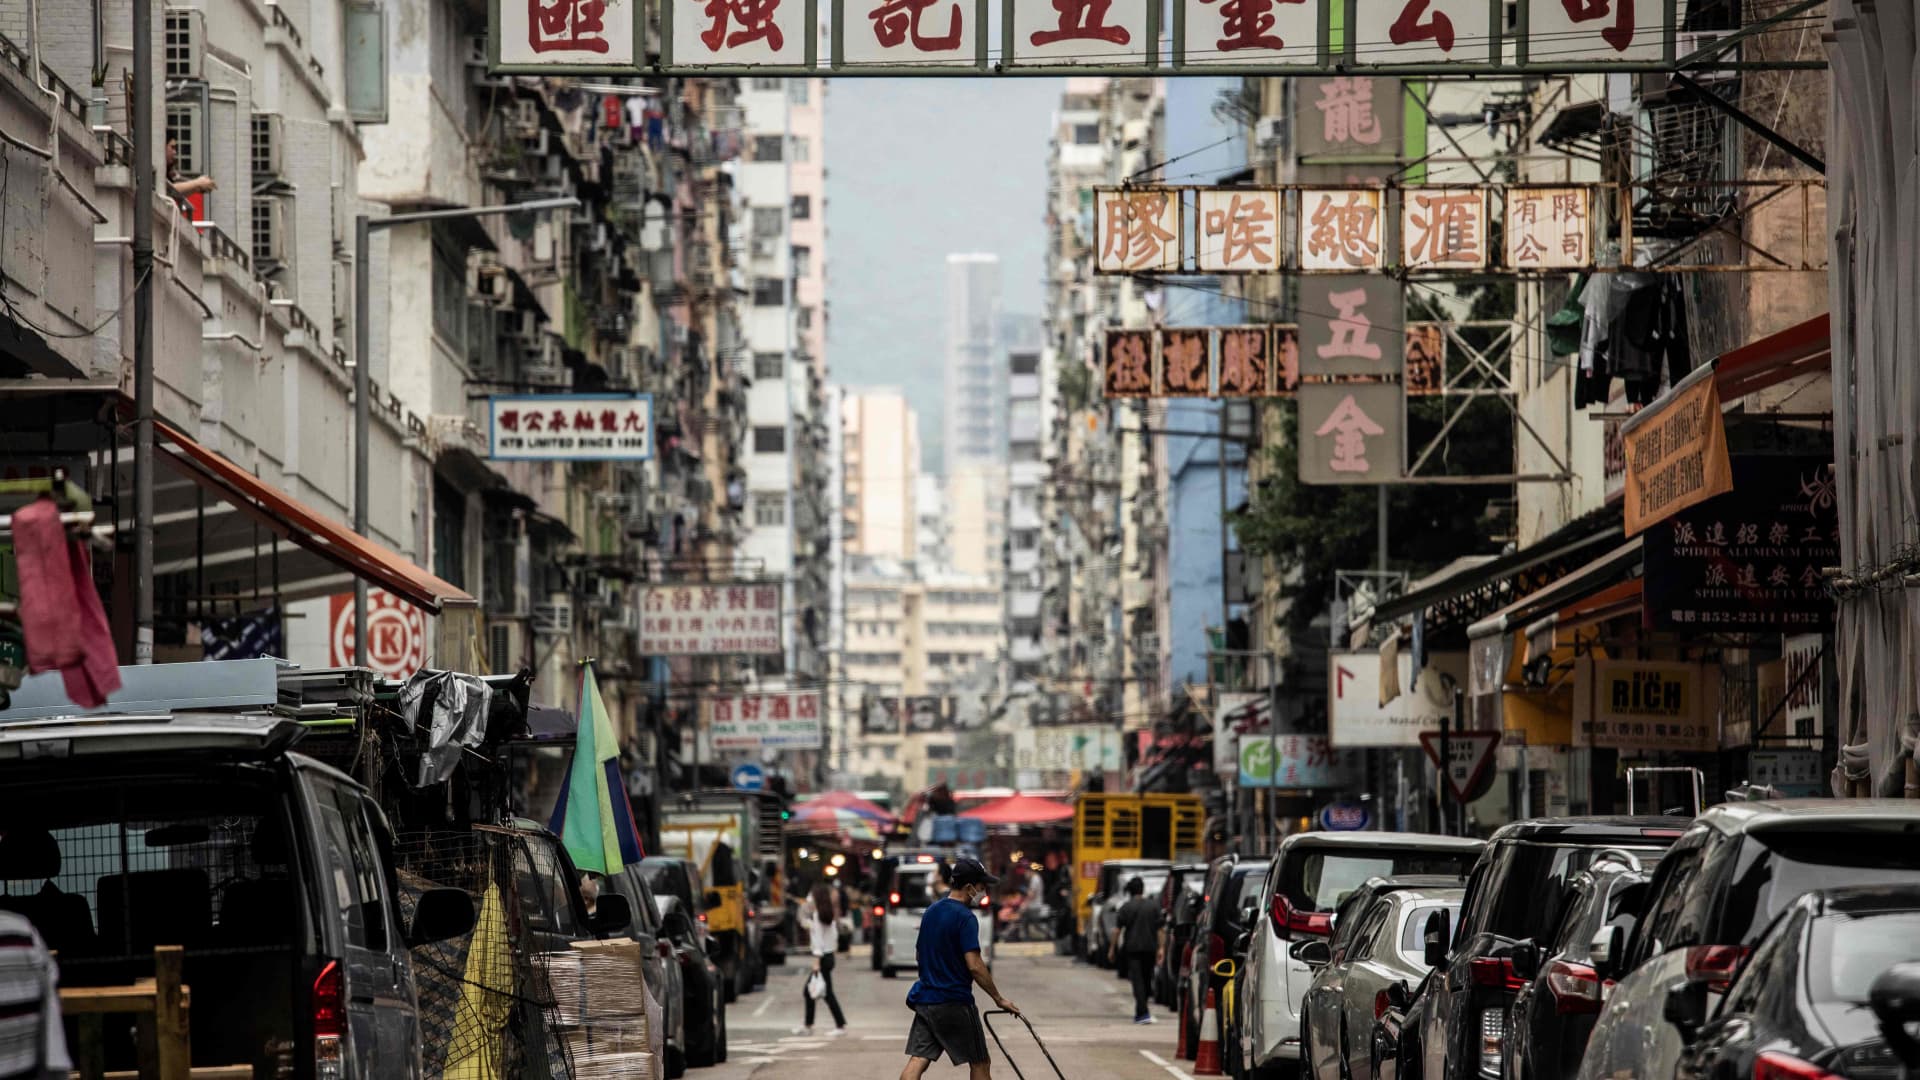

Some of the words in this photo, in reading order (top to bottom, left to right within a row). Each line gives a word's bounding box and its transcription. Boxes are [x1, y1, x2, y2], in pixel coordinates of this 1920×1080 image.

[1512, 193, 1586, 225] 有限
[1512, 230, 1586, 264] 公司
[528, 437, 573, 448] LIMITED
[578, 437, 613, 448] SINCE
[1673, 547, 1721, 557] SPIDER
[1729, 547, 1801, 557] ALUMINUM
[1808, 547, 1840, 557] TOW
[1695, 589, 1744, 599] SPIDER
[1783, 610, 1819, 624] 1932
[1612, 679, 1681, 709] RICH
[1447, 741, 1473, 749] GIVE
[1447, 753, 1473, 761] WAY
